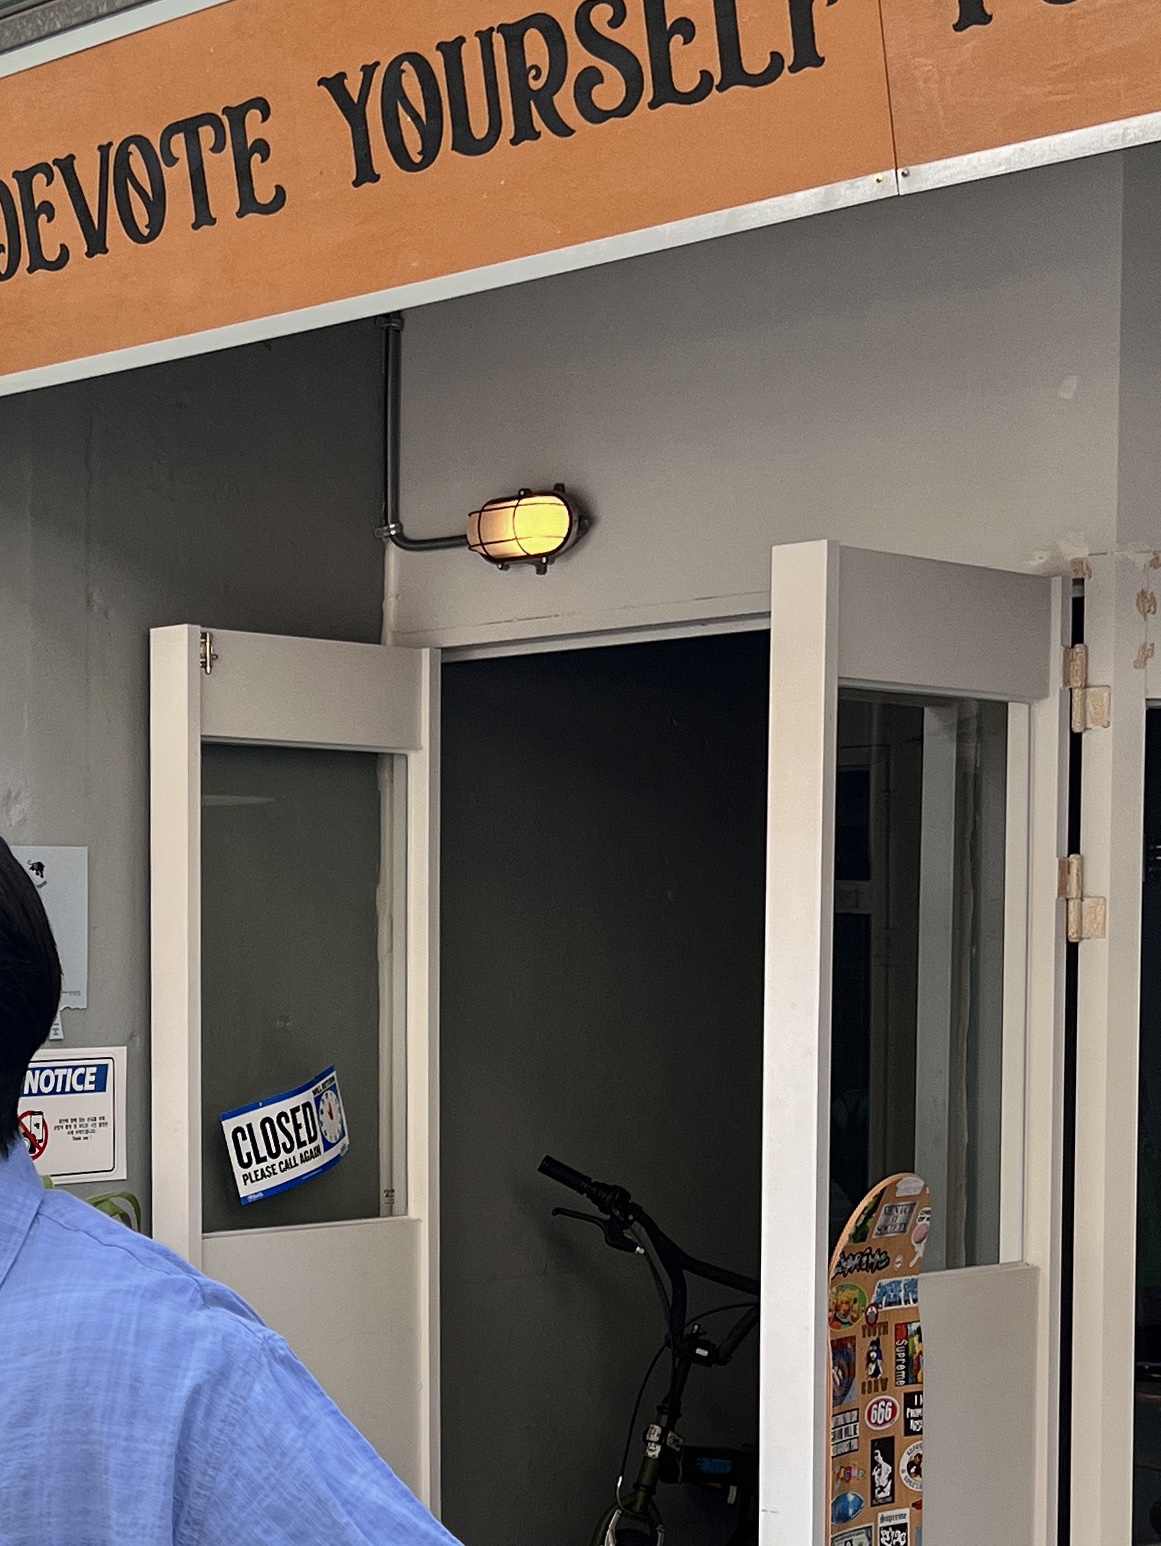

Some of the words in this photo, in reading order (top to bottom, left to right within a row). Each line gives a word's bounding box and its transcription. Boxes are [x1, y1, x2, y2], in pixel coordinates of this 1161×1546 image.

[23, 1067, 98, 1095] NOTICE
[231, 1100, 318, 1170] CLOSED
[242, 1164, 278, 1186] PLEASE
[278, 1155, 299, 1173] CALL
[299, 1144, 321, 1165] AGAIN
[895, 1339, 909, 1386] Supreme
[871, 1400, 893, 1424] 666
